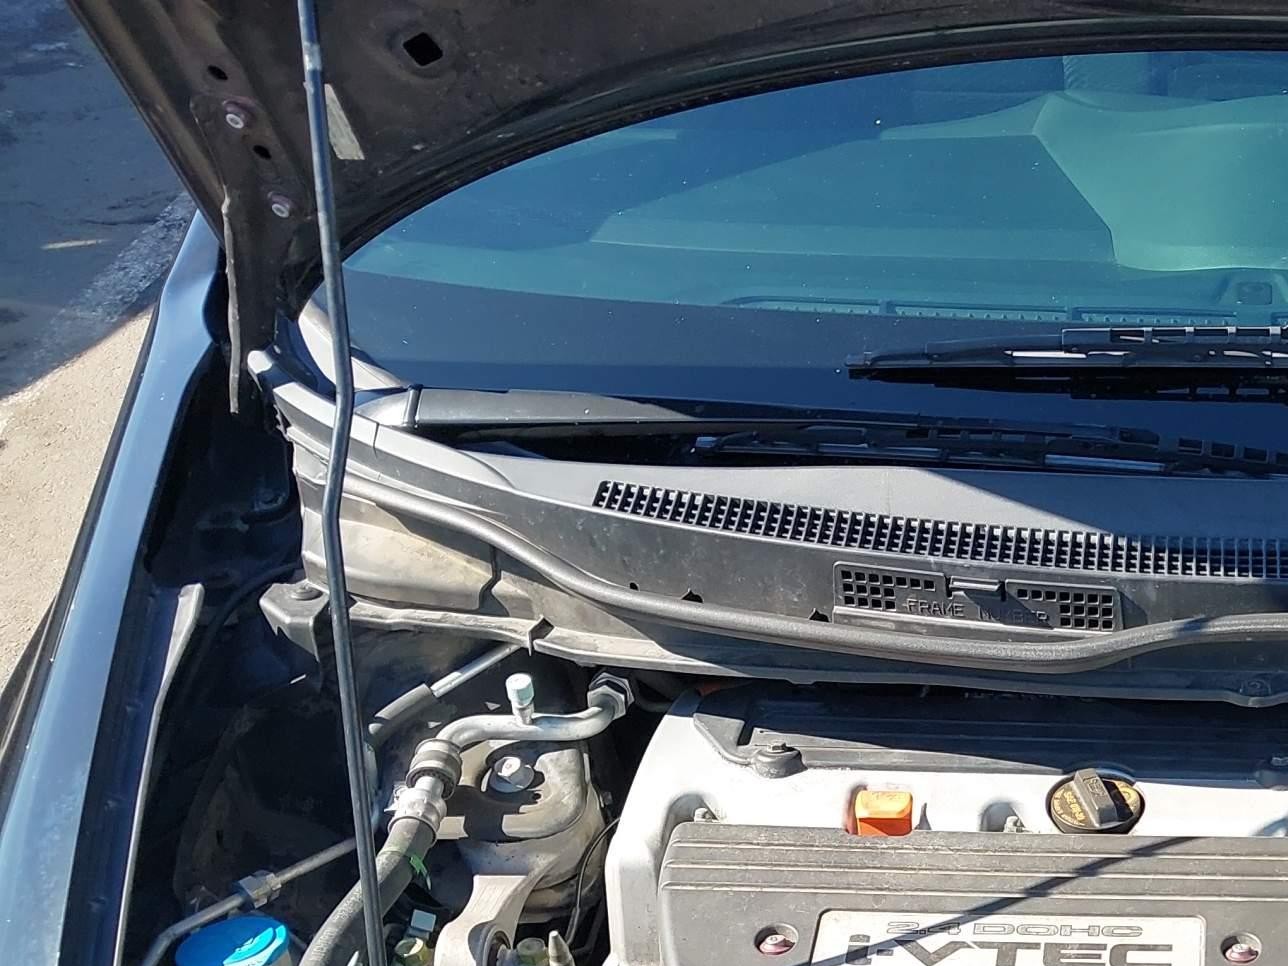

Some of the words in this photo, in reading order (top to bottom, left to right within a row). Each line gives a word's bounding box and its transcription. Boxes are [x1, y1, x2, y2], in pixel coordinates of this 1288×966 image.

[905, 598, 965, 617] FRAME
[887, 920, 961, 936] 2.4
[973, 922, 1143, 938] DOHC
